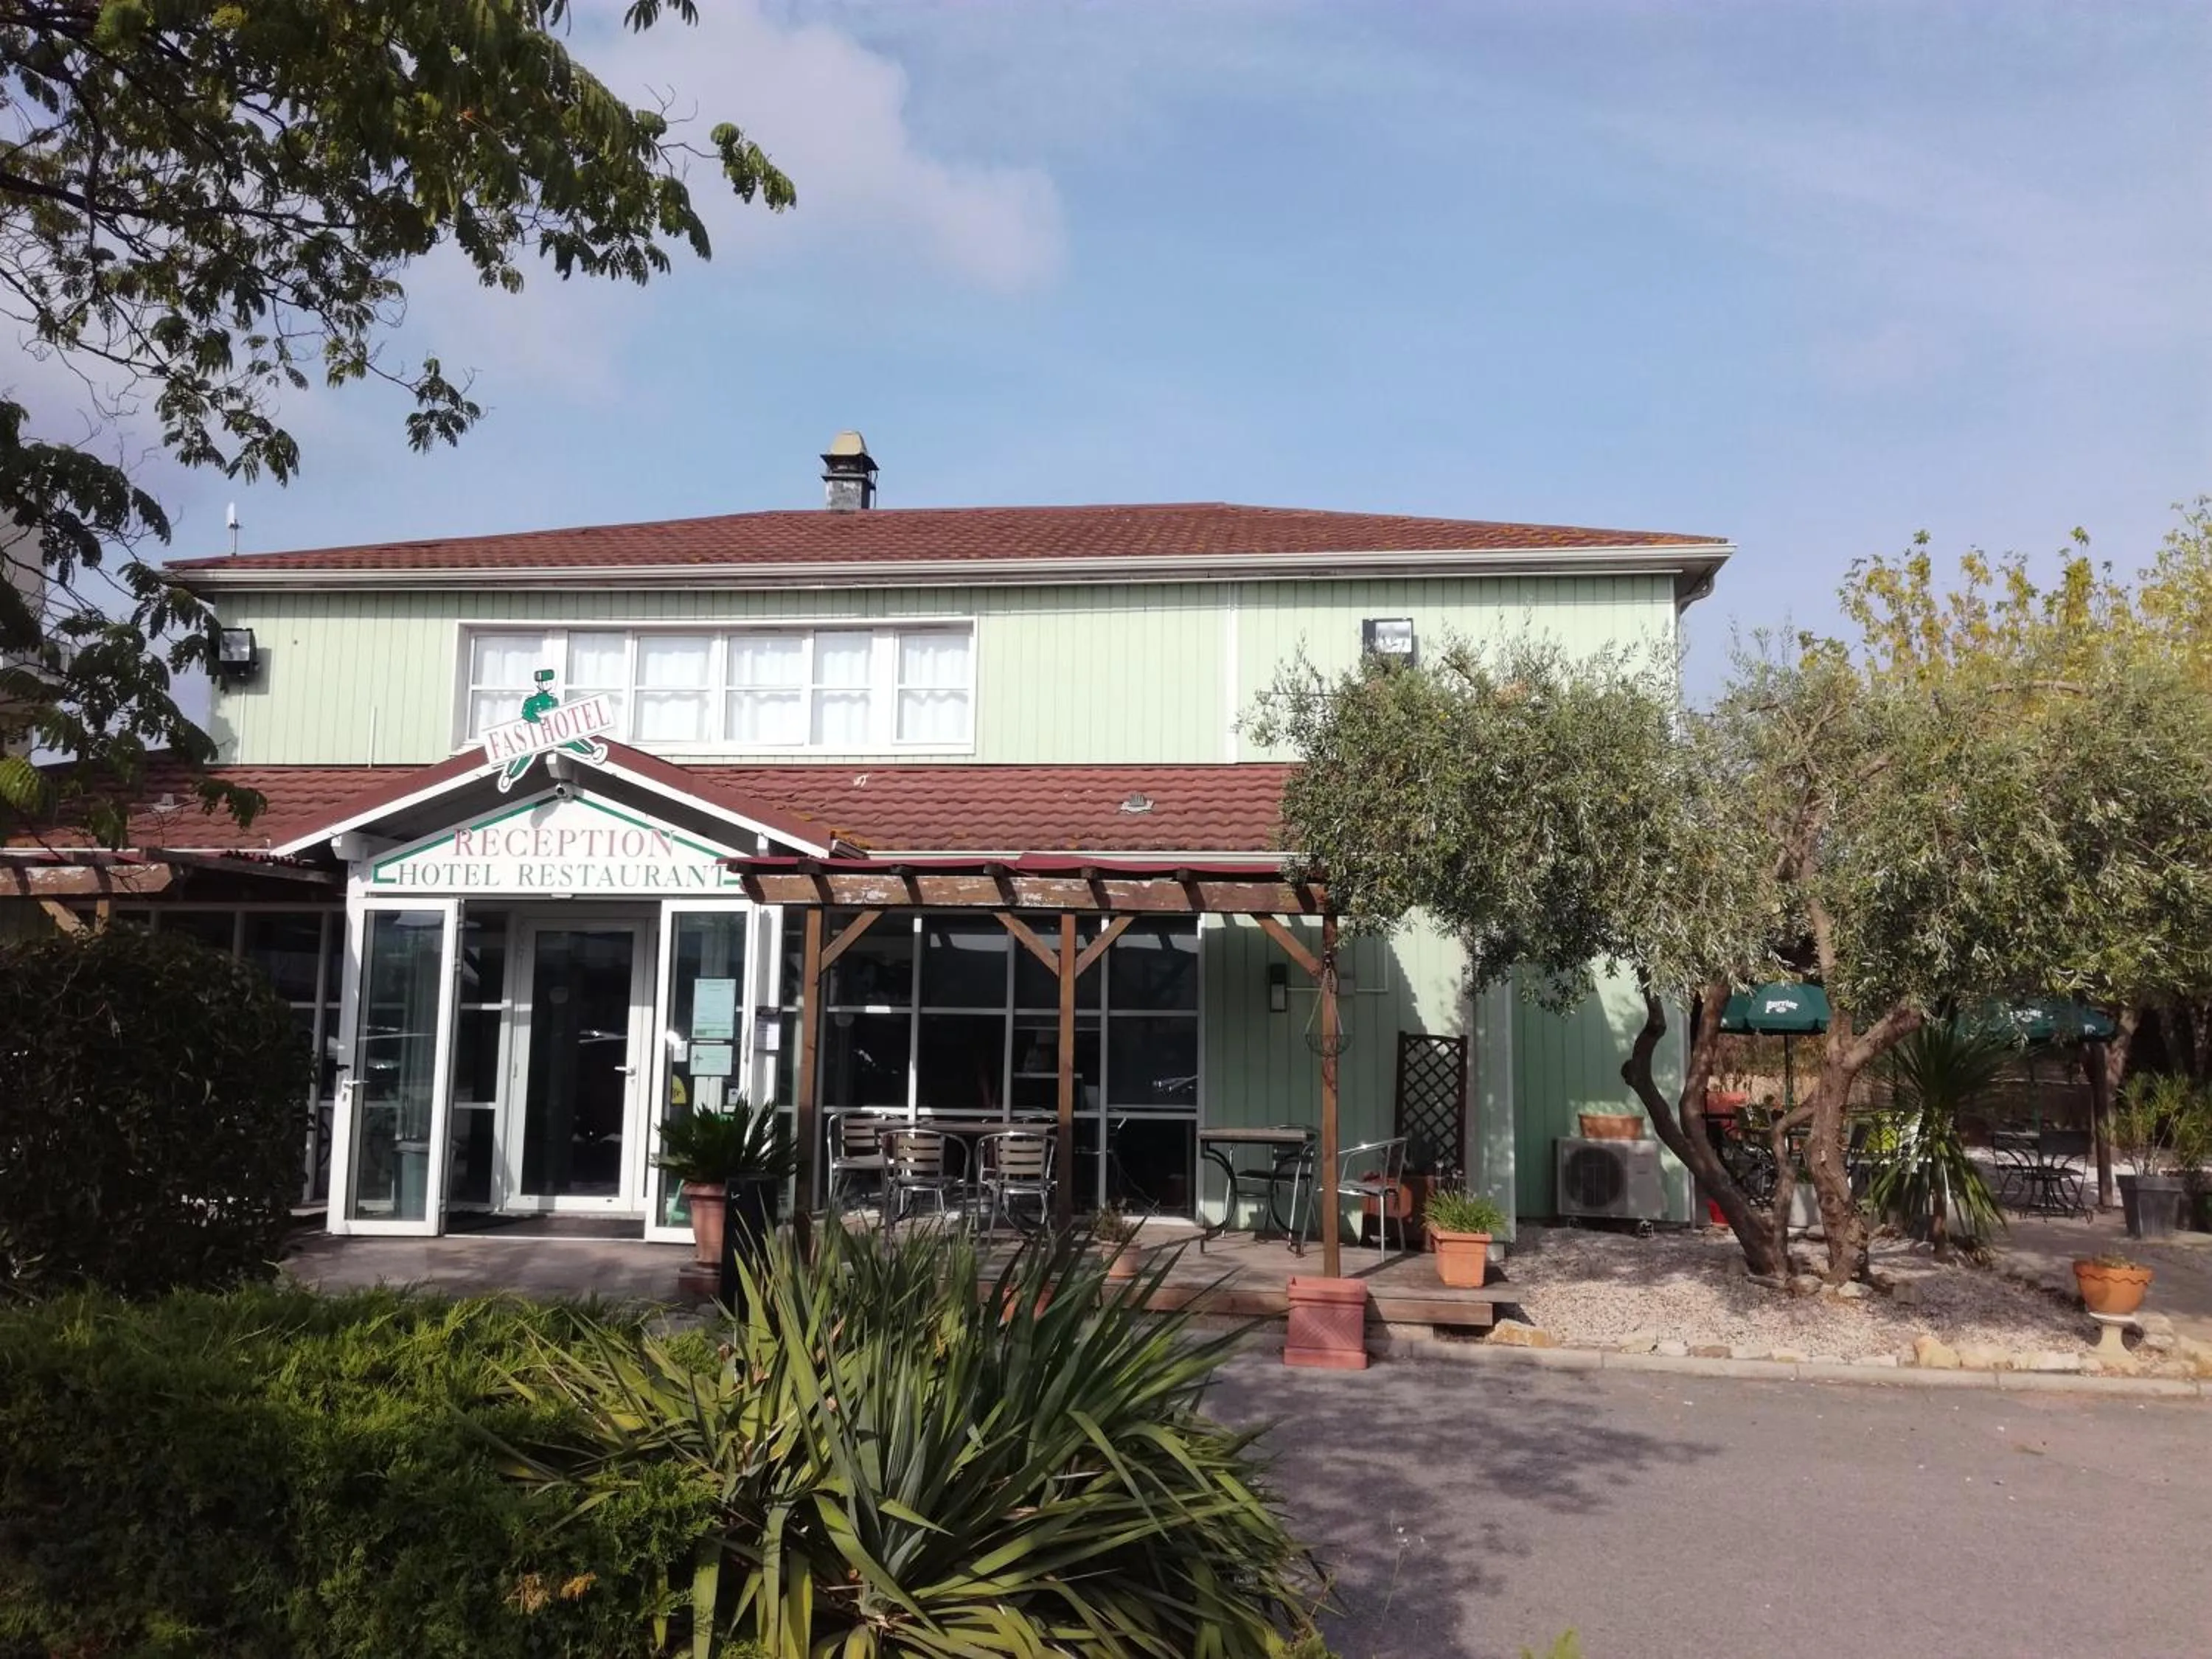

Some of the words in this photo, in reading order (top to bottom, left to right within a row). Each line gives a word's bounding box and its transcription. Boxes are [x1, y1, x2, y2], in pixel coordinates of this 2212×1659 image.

[453, 828, 675, 858] RECEPTION
[399, 863, 500, 886] HOTEL
[518, 863, 726, 888] RESTAURANT
